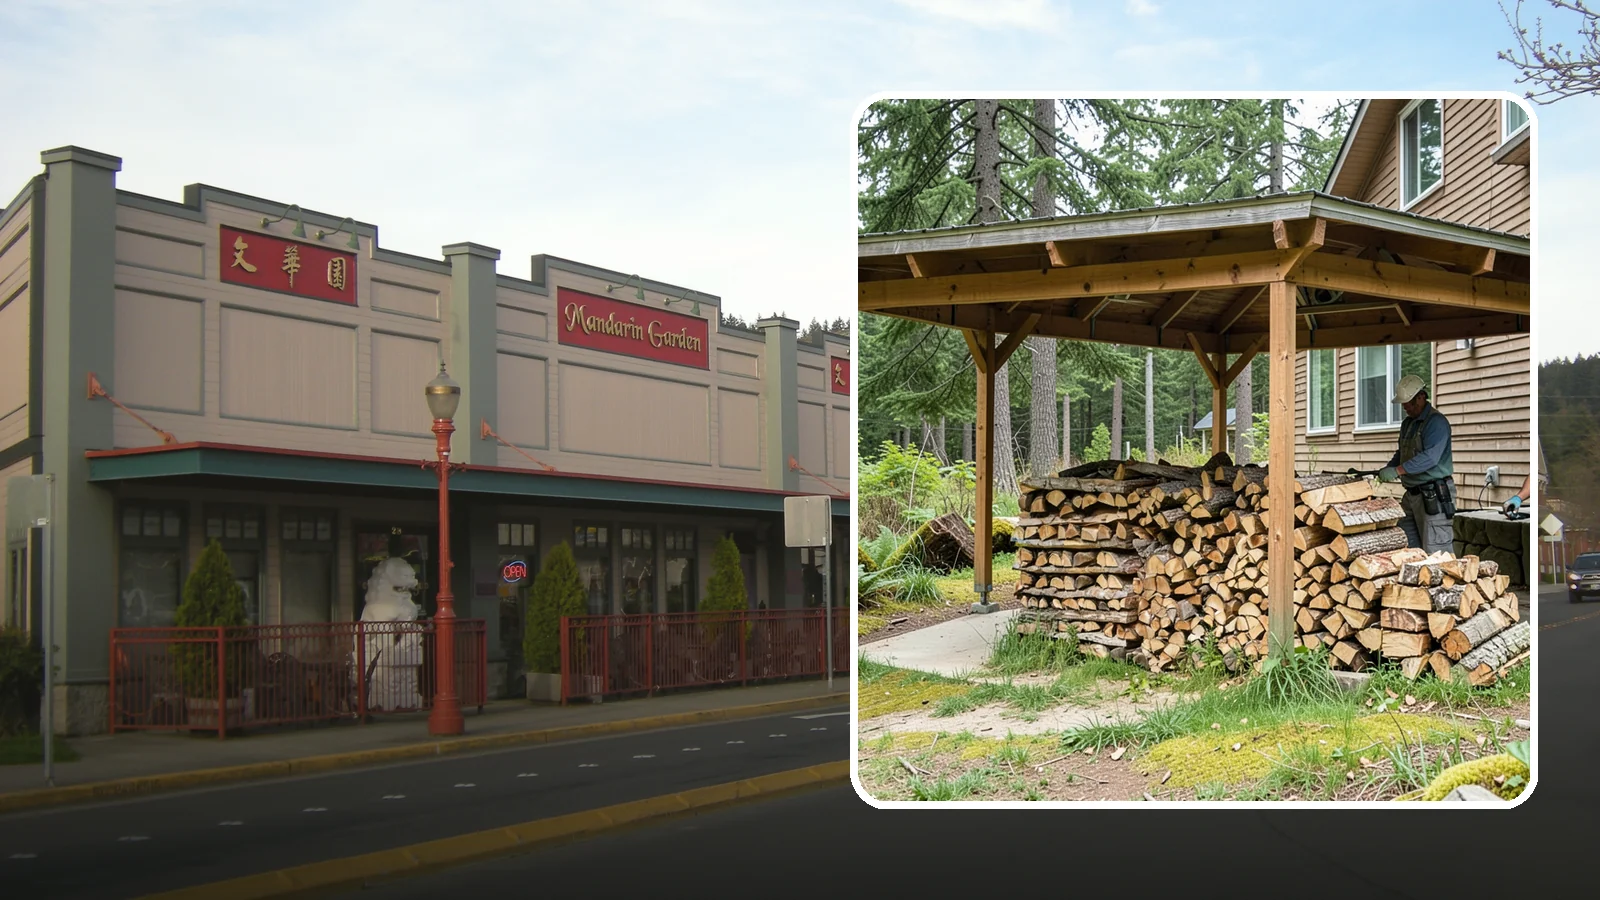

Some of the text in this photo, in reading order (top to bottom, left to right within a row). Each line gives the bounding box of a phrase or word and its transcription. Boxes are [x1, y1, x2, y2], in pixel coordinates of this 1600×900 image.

[231, 235, 346, 291] 文華園
[565, 302, 702, 352] Mandarin Garden
[834, 362, 846, 386] 文
[503, 565, 526, 578] OPEN
